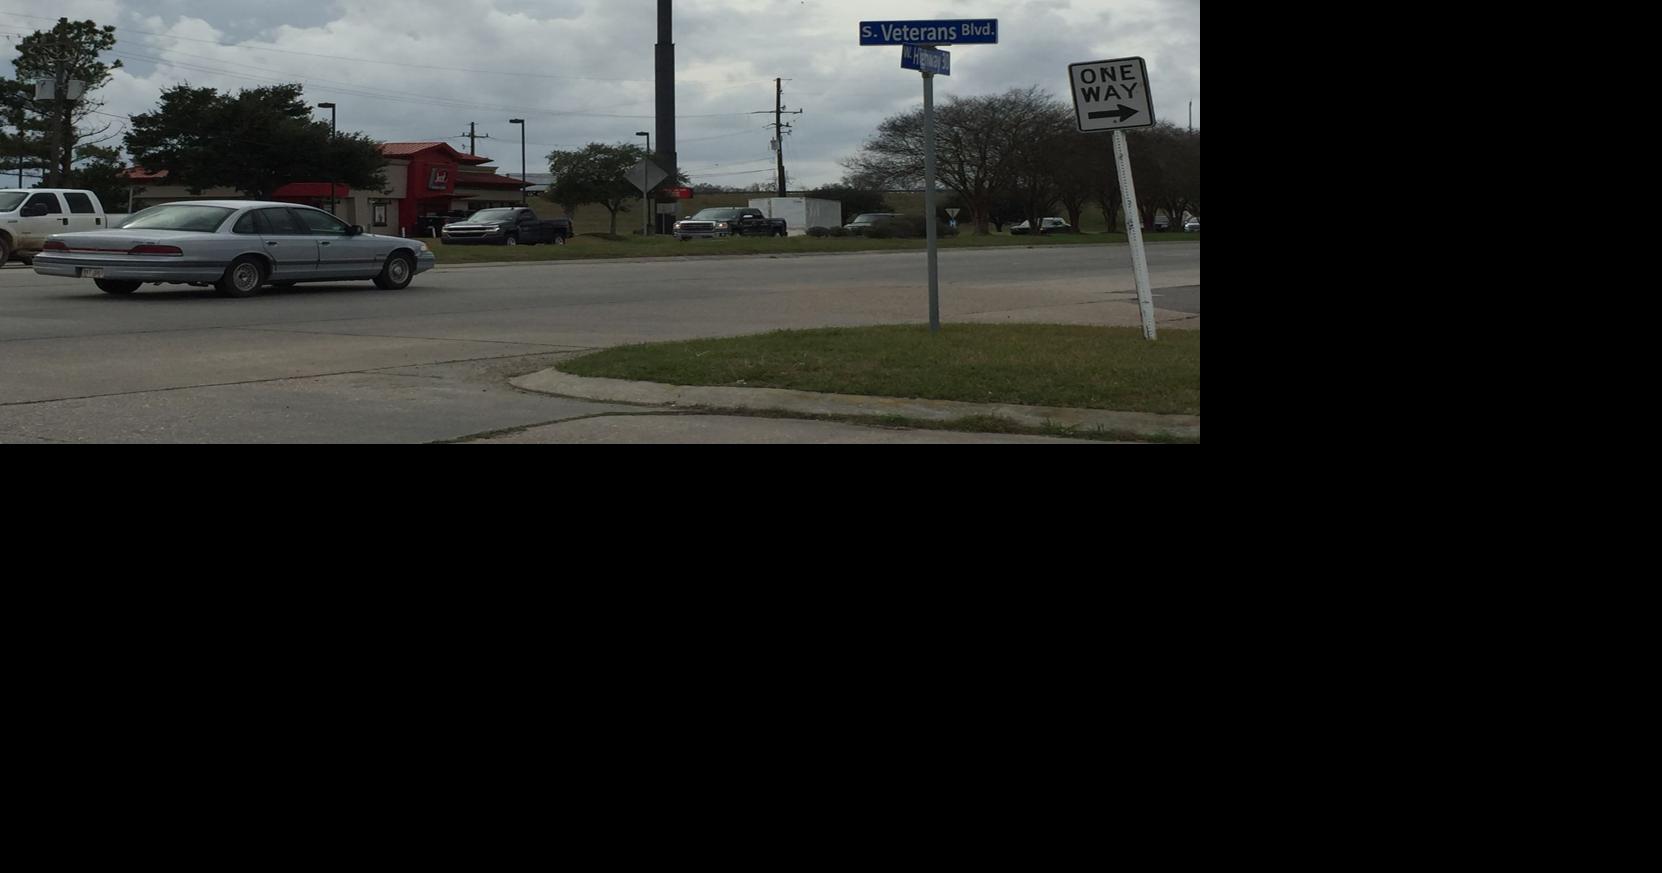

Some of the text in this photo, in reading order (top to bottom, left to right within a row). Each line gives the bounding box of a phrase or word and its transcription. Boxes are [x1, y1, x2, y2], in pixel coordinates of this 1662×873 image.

[862, 22, 995, 41] S. Veterans Blvd.
[1080, 64, 1135, 84] ONE
[1080, 82, 1138, 103] WAY
